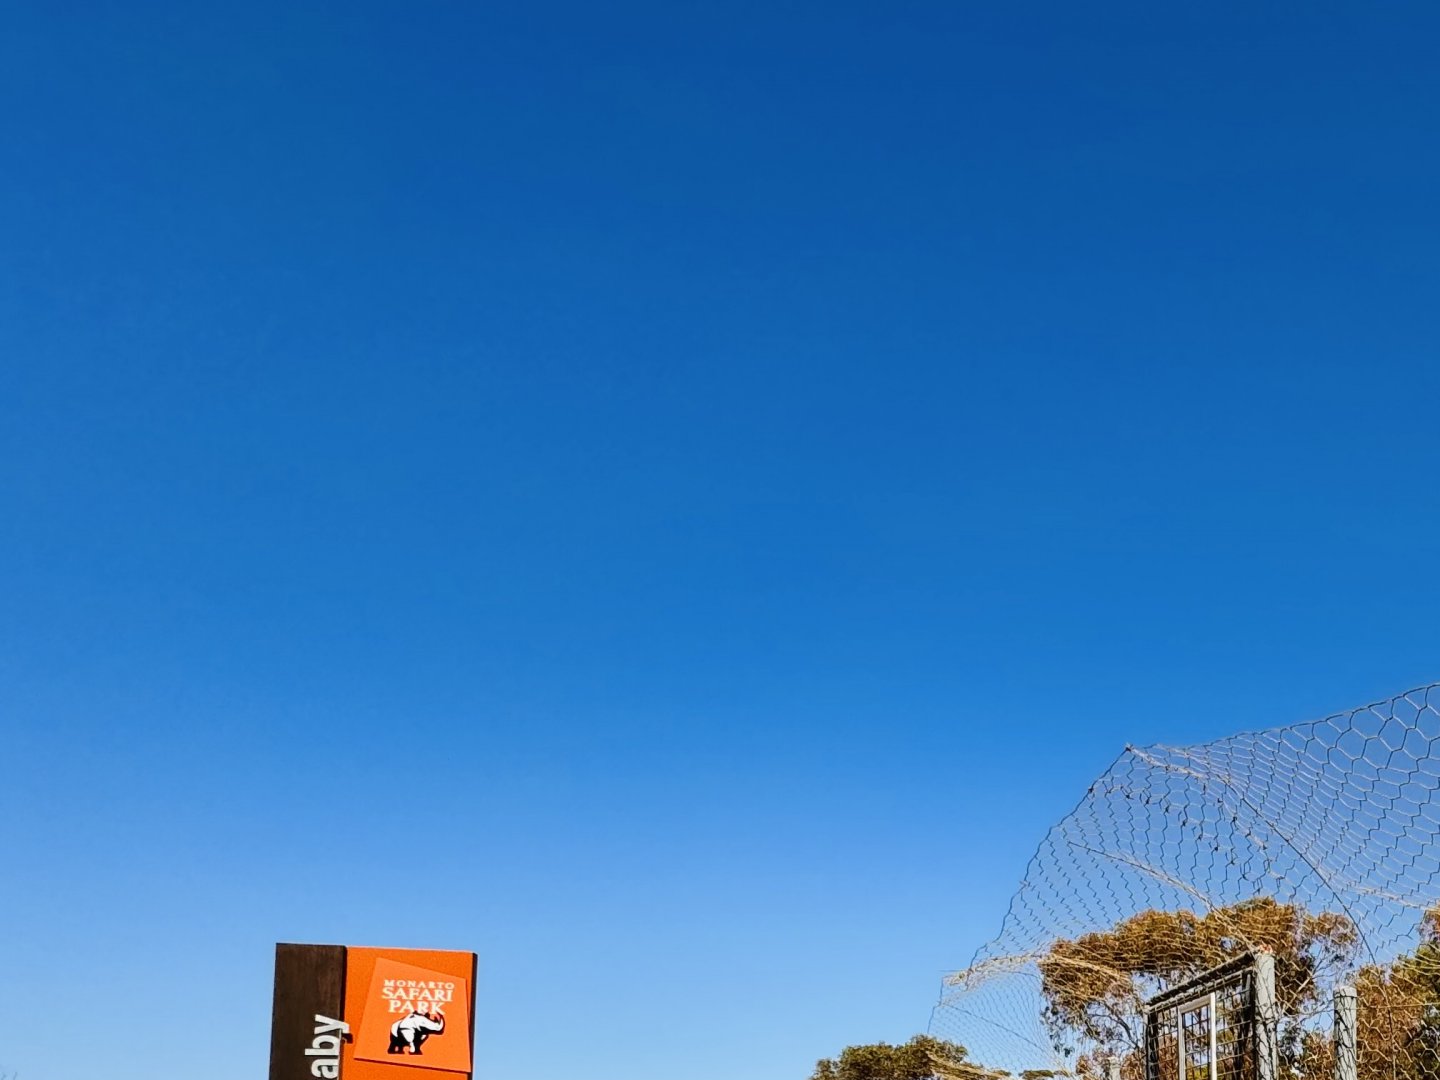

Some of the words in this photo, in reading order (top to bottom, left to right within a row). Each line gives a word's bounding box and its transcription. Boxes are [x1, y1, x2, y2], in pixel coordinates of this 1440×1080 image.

[384, 979, 455, 990] MONARTO
[382, 987, 454, 1002] SAFARI
[388, 1000, 446, 1015] PARK
